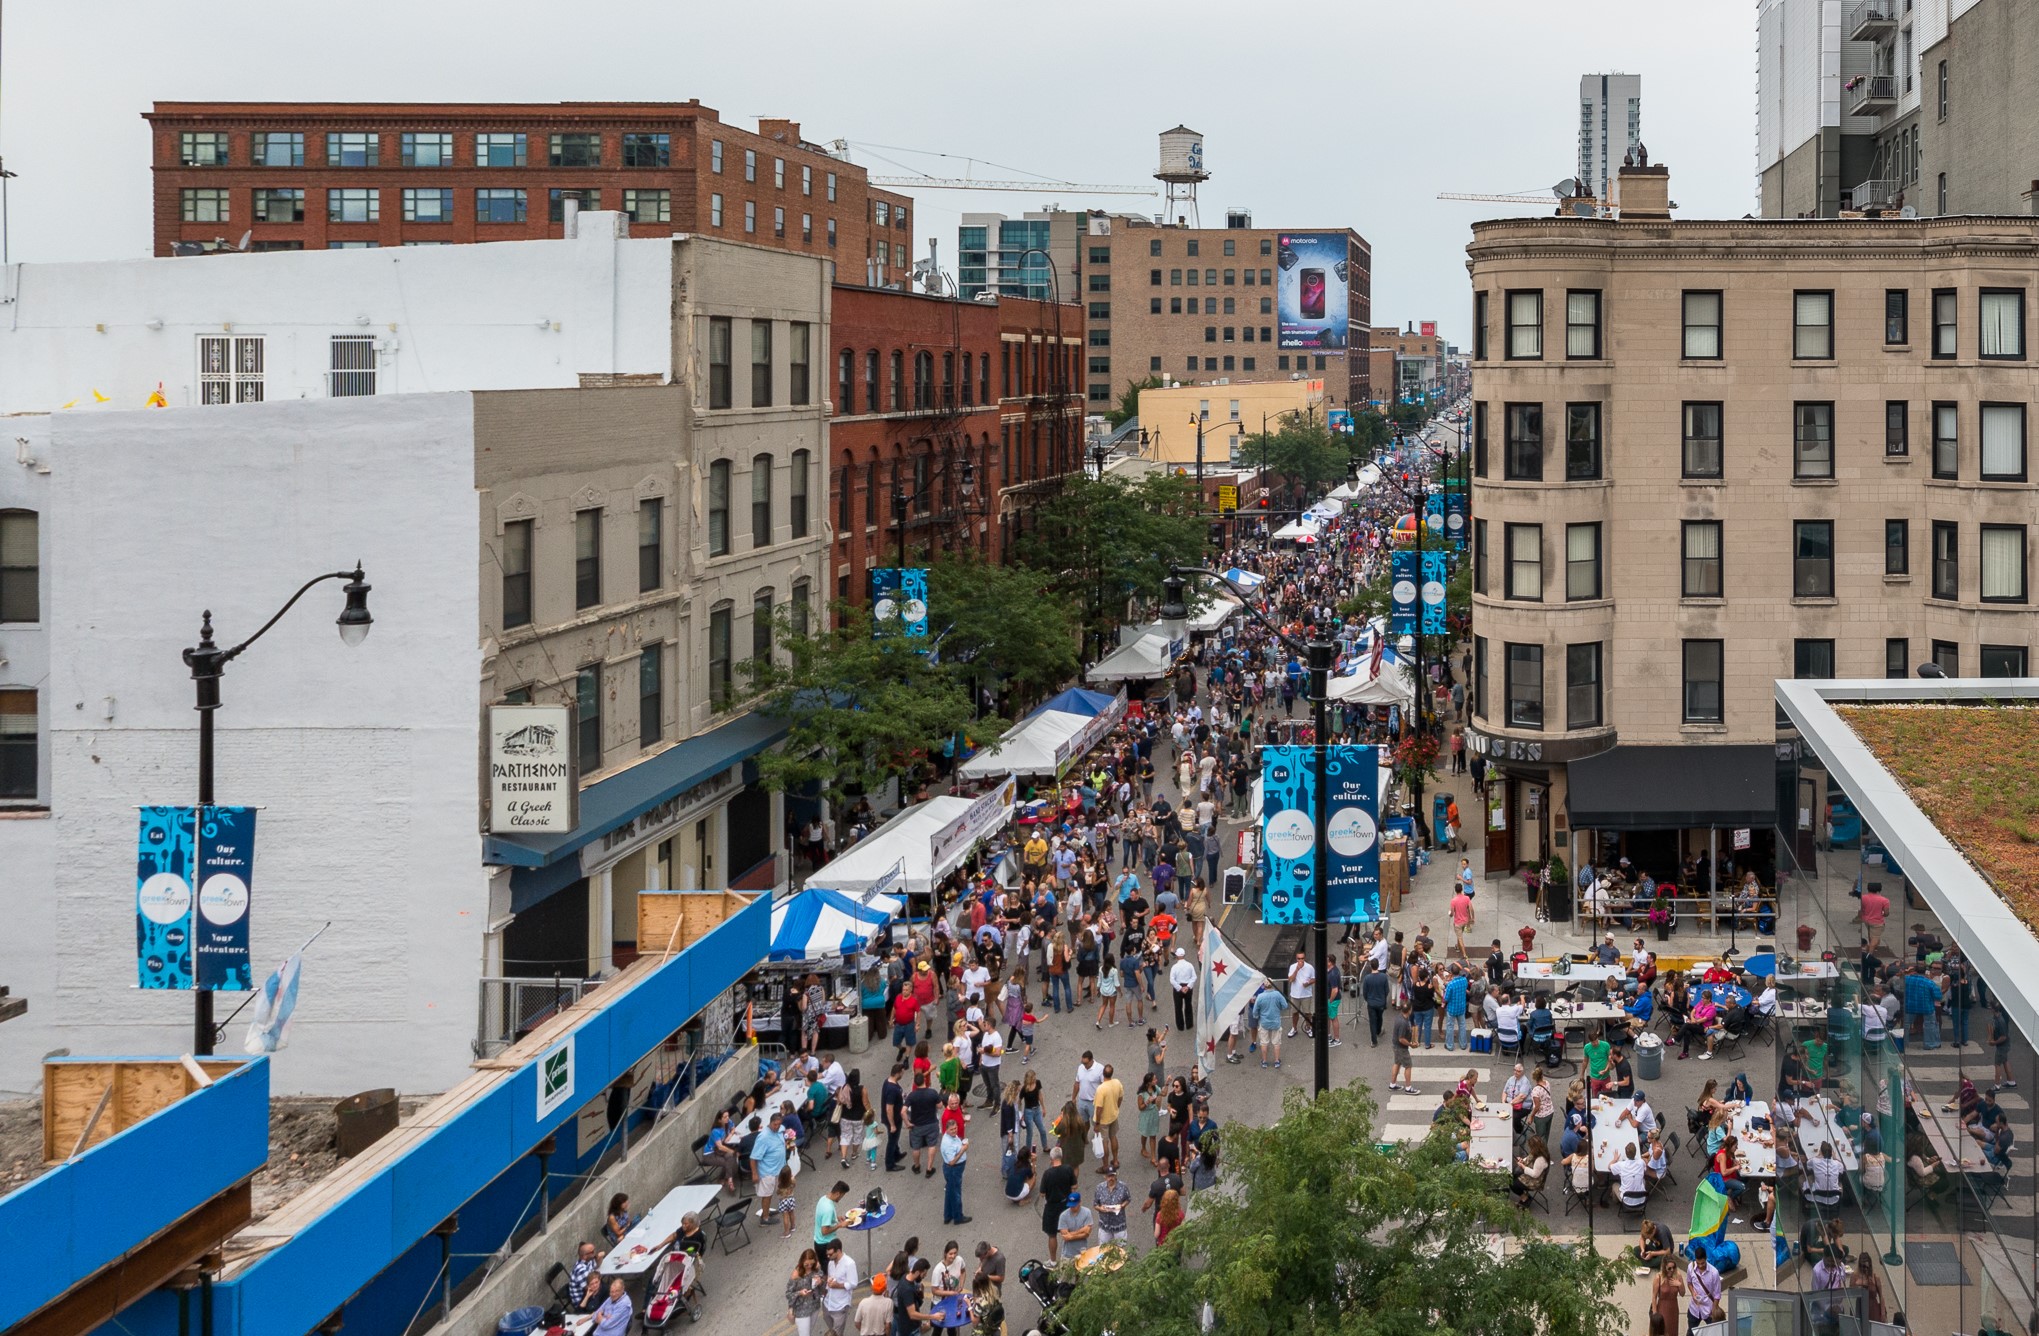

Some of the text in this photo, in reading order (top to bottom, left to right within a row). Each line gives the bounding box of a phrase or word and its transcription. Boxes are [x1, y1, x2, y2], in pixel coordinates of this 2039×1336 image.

[493, 763, 567, 778] PARTHENON
[1274, 770, 1287, 778] Eat
[501, 782, 557, 792] RESTAURANT
[1342, 781, 1361, 790] Our
[1332, 793, 1371, 801] culture.
[507, 800, 552, 815] A Greek
[510, 815, 550, 826] Classic
[150, 831, 163, 839] Eat
[216, 845, 235, 856] Our
[206, 856, 245, 866] culture.
[1293, 868, 1311, 877] Shop
[1341, 864, 1363, 873] Your
[1327, 875, 1377, 885] adventure.
[1272, 895, 1289, 903] Play
[167, 933, 184, 942] Shop
[212, 933, 233, 944] Your
[198, 945, 248, 954] adventure.
[147, 960, 163, 969] Play
